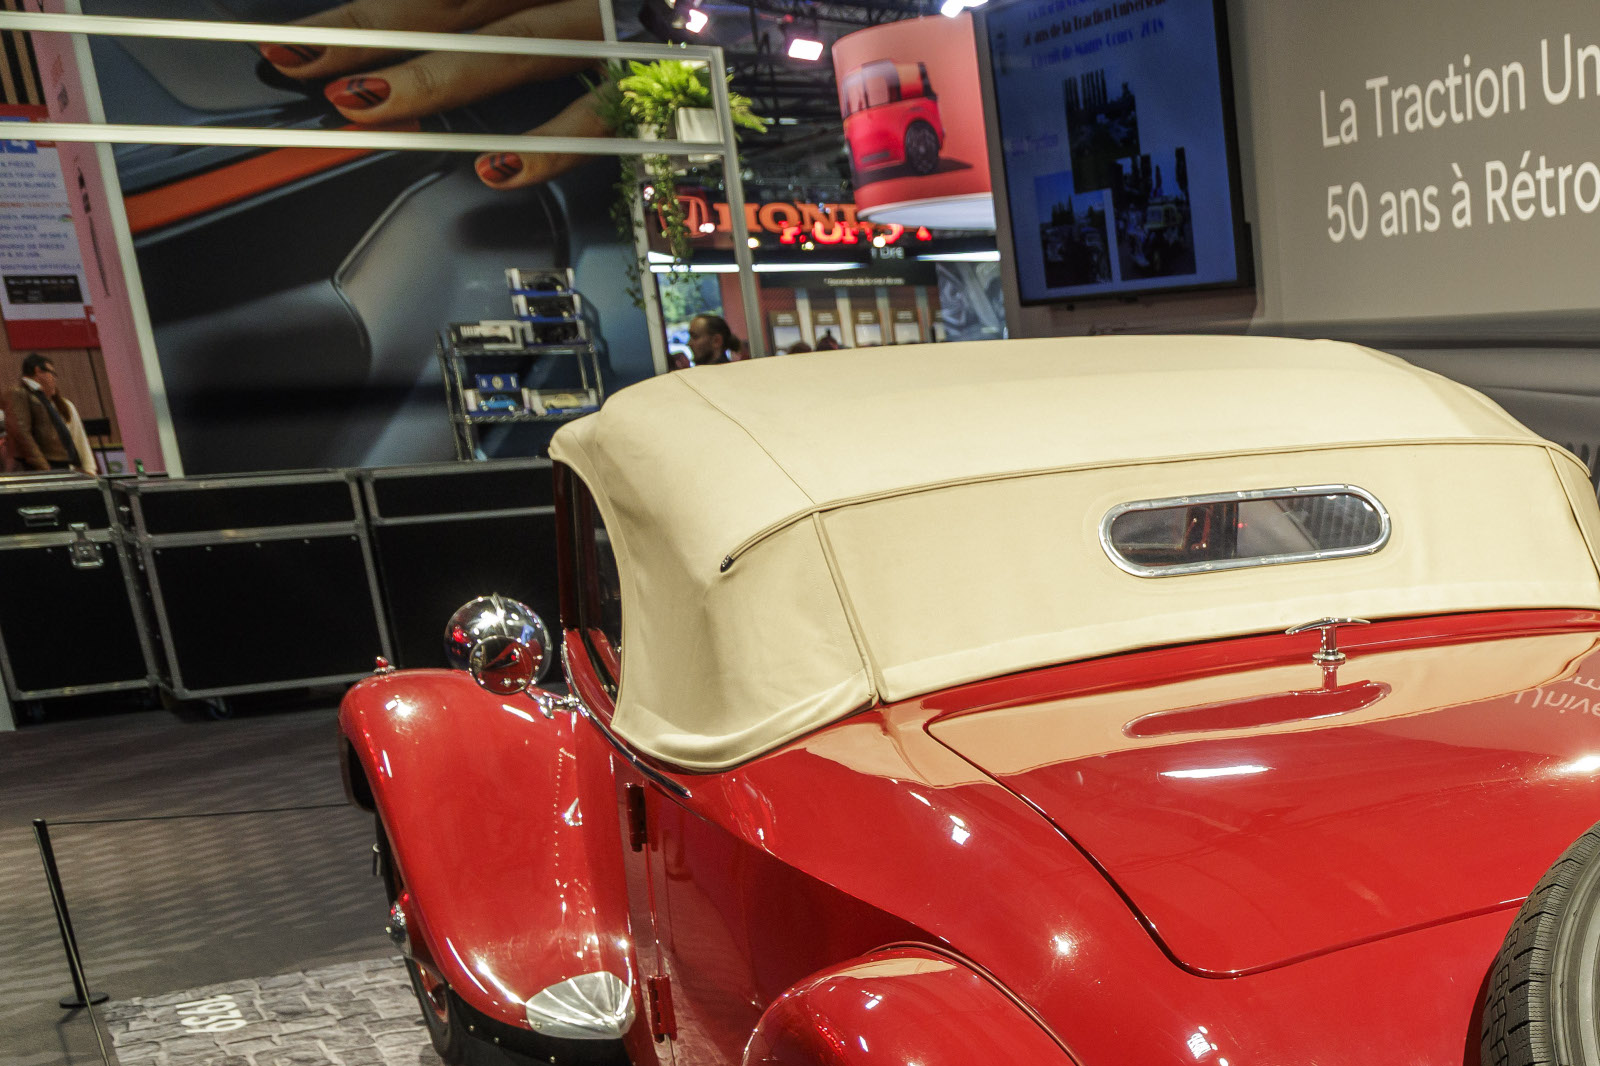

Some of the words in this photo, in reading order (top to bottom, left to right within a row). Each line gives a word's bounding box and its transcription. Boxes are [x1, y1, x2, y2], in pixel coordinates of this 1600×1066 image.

[1319, 89, 1358, 148] La
[1366, 53, 1526, 138] Traction
[1326, 181, 1369, 243] 50
[1379, 181, 1441, 238] ans
[1451, 162, 1472, 228] à
[175, 993, 248, 1034] 1939
